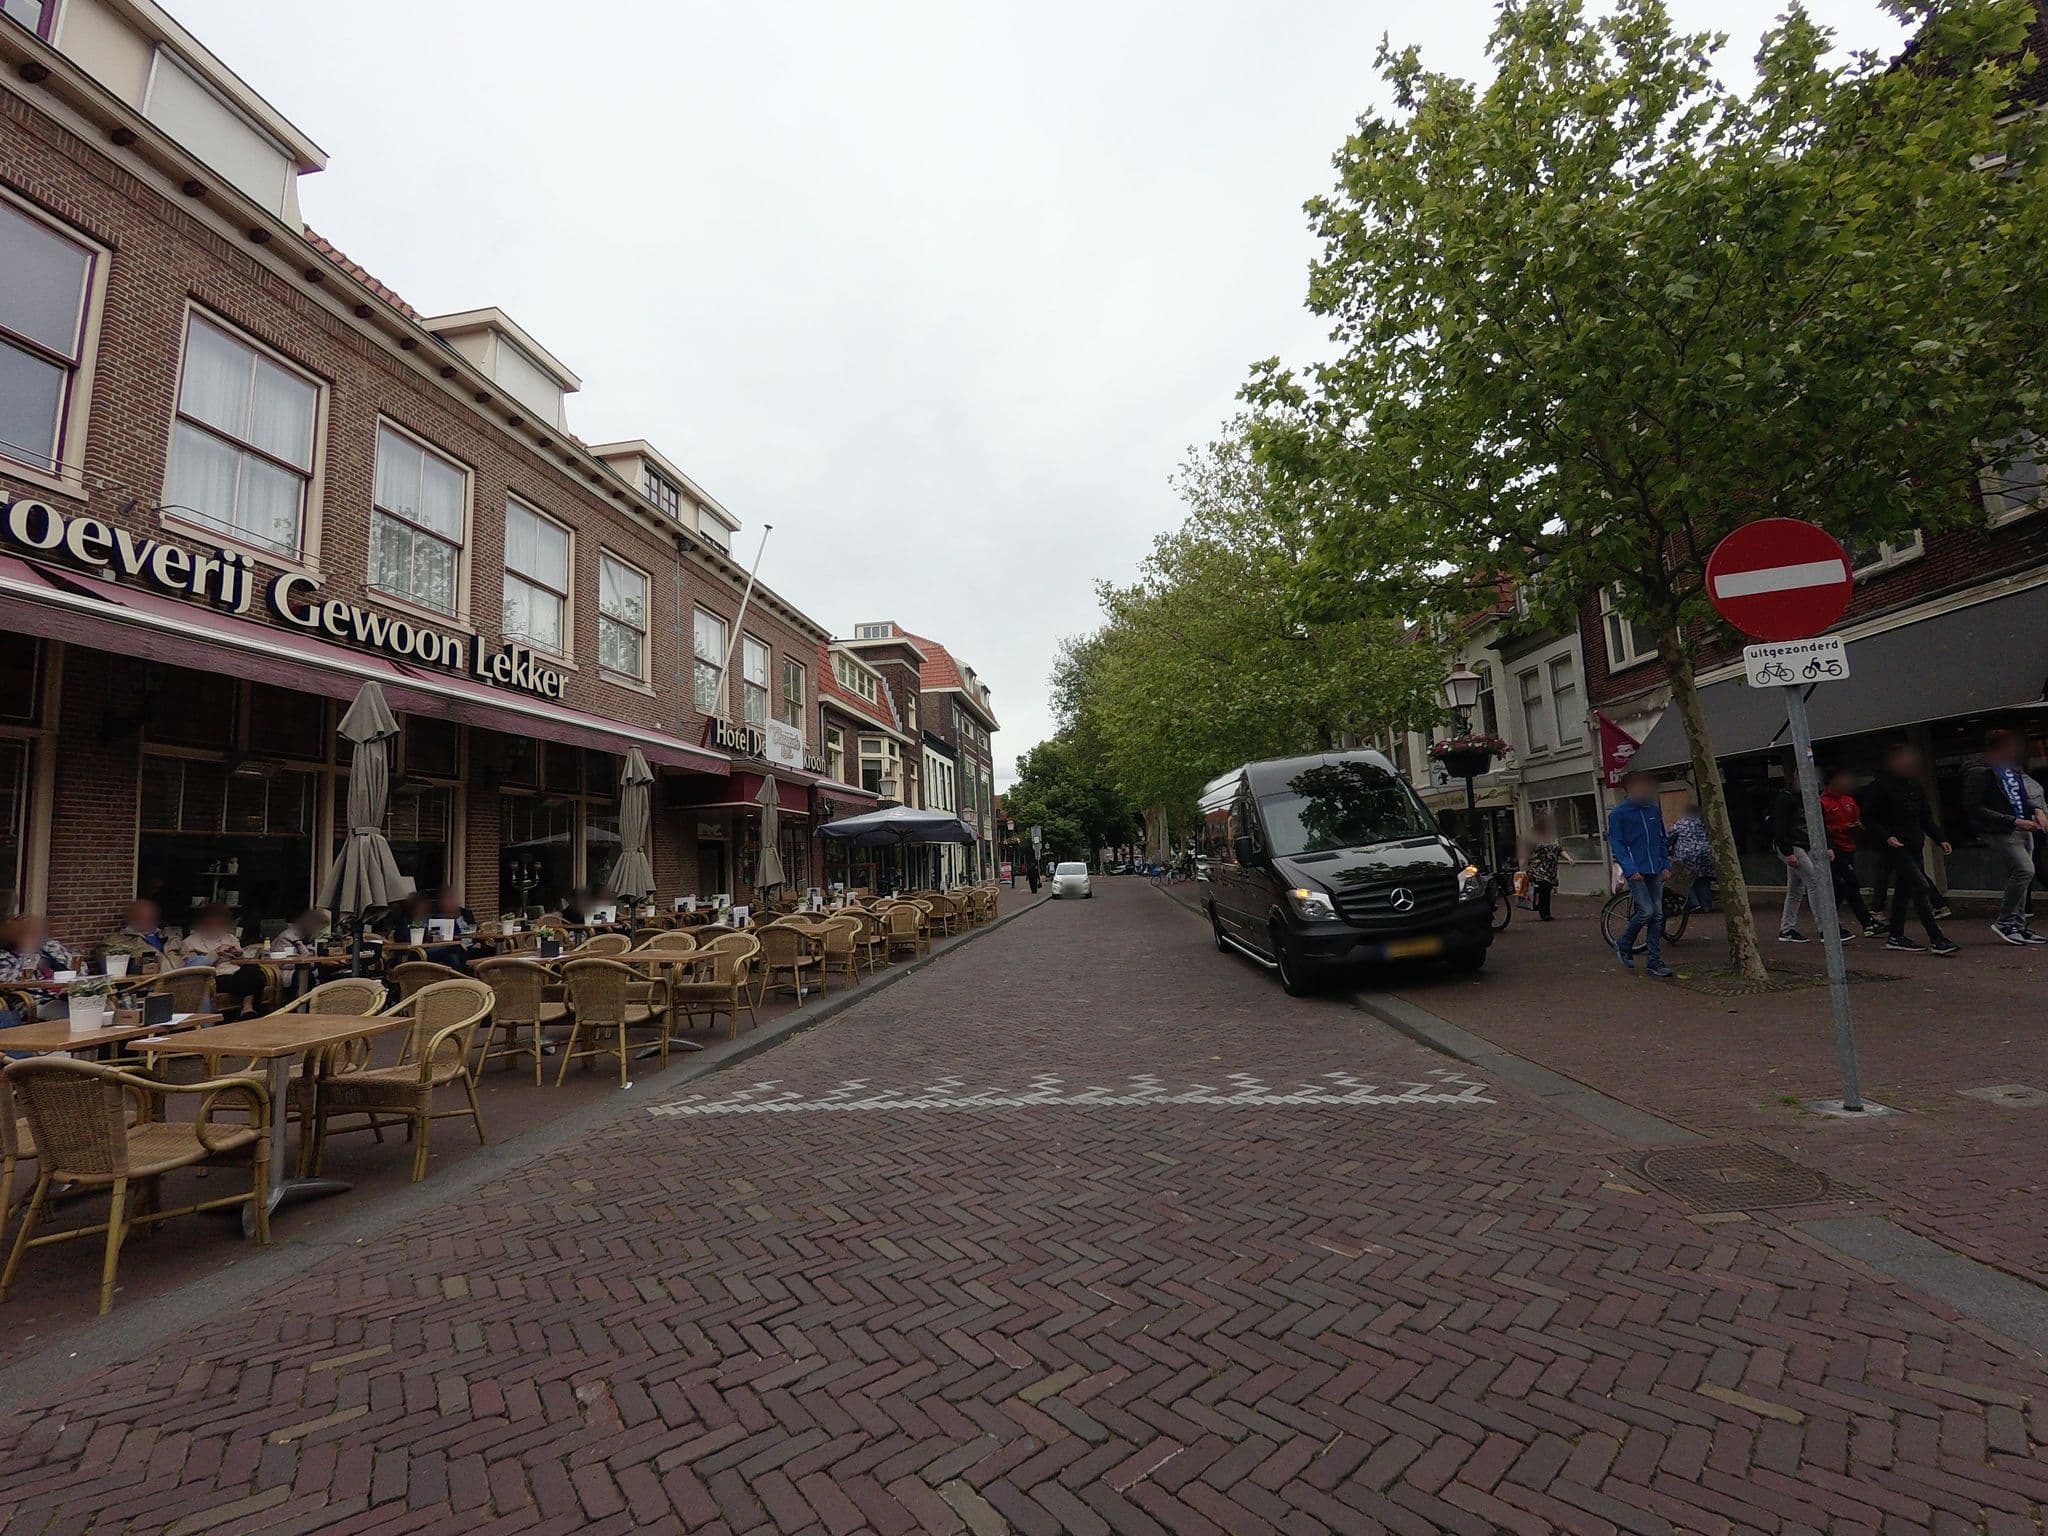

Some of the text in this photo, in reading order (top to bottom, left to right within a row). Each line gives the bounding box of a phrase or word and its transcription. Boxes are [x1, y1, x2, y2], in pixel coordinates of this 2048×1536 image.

[0, 490, 570, 699] oeverij Gewoon Lekker
[1750, 639, 1839, 659] uitgezonderd
[715, 718, 750, 752] Hotel
[803, 747, 827, 773] kroon
